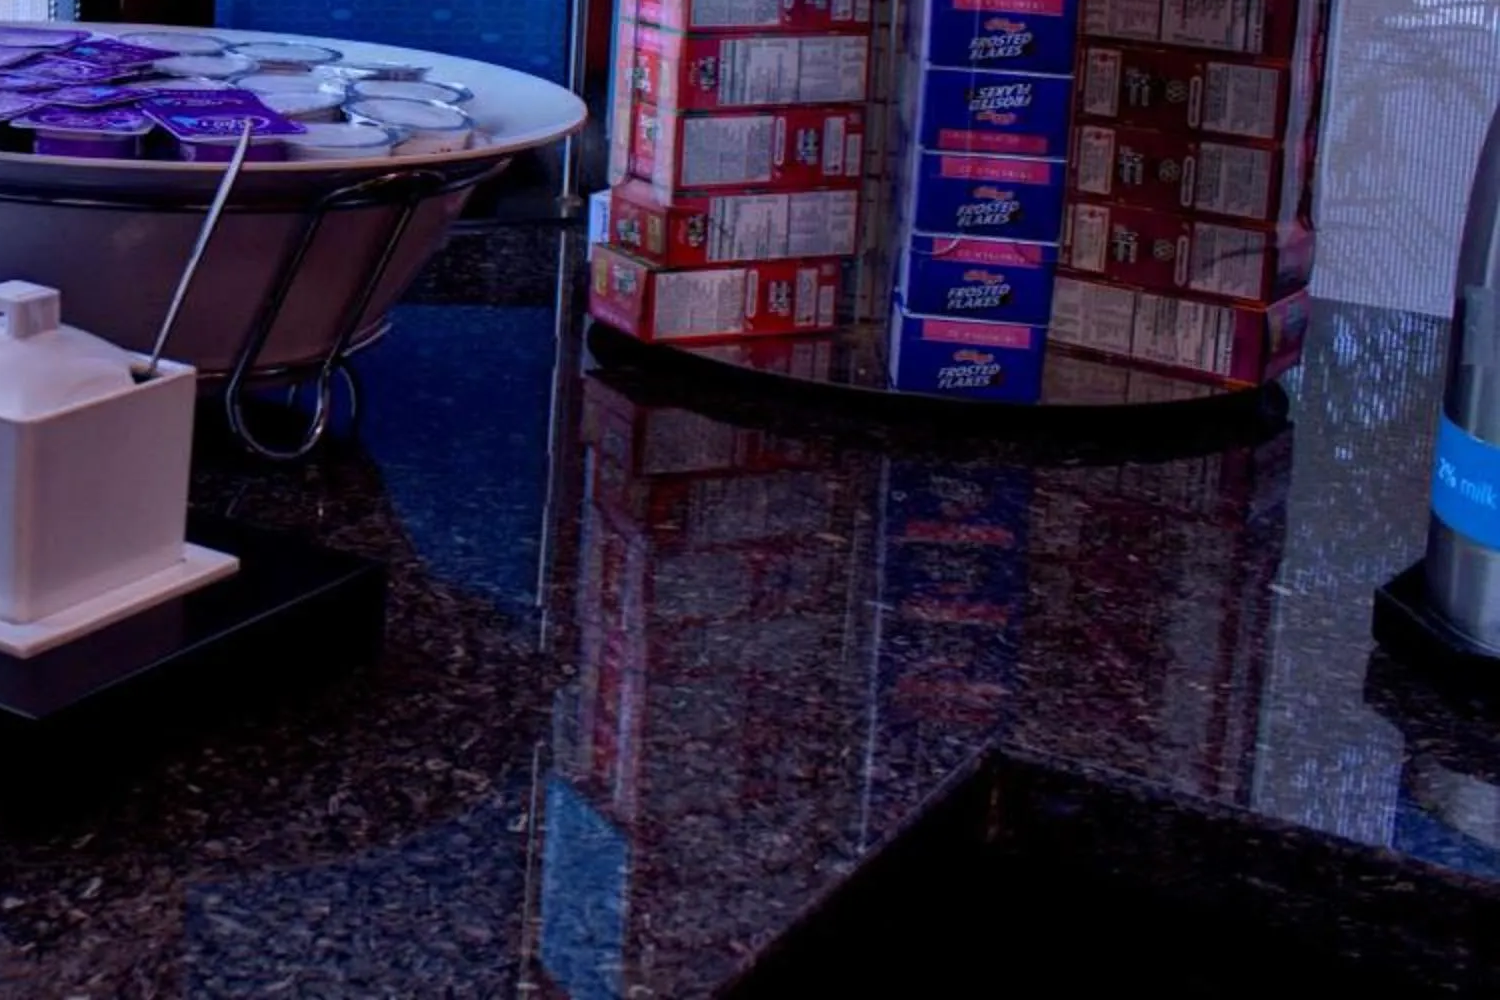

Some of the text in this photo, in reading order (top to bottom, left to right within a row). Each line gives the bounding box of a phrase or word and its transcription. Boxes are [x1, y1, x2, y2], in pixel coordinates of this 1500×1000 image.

[968, 32, 1033, 49] FROSTED
[968, 46, 1023, 61] FLAKES
[947, 283, 1012, 299] FROSTED
[947, 296, 1001, 310] FLAKES
[936, 363, 1001, 380] FROSTED
[936, 376, 993, 390] FLAKES
[1459, 477, 1498, 511] milk
